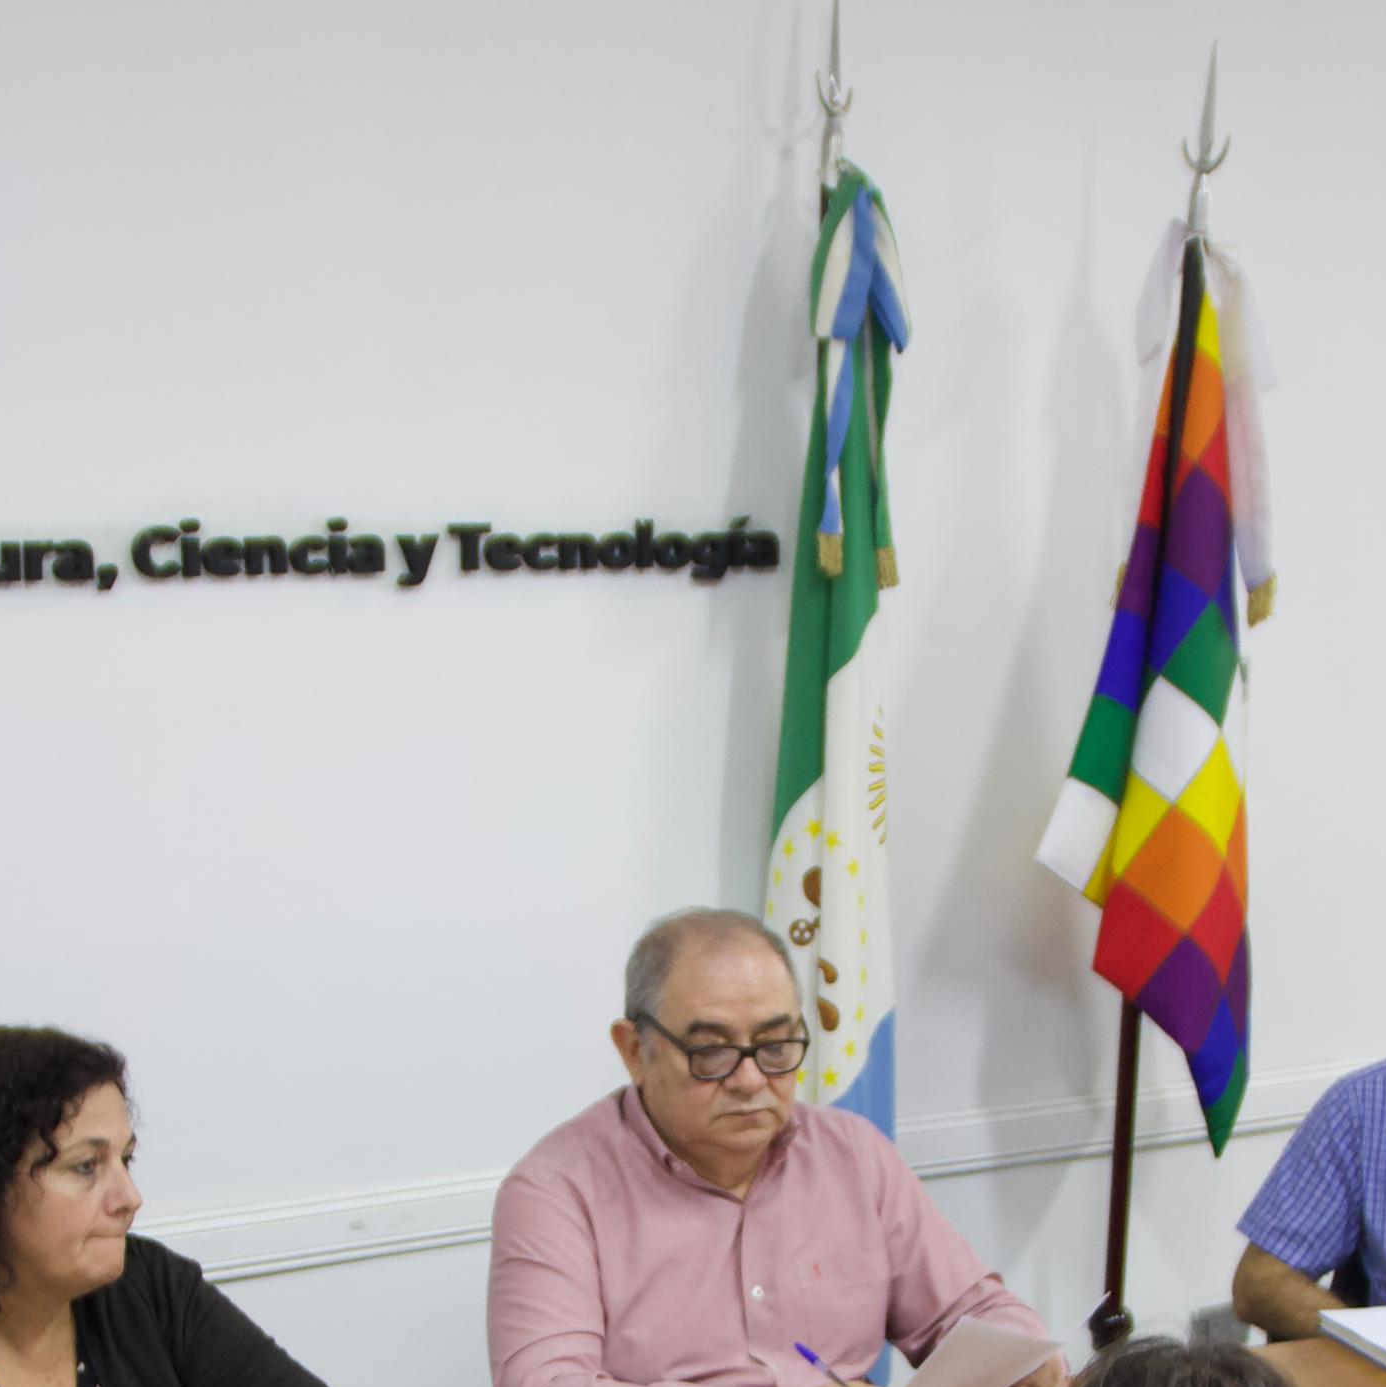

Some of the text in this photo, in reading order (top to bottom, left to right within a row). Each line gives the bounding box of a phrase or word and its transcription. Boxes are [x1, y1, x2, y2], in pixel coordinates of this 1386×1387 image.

[130, 516, 387, 579] Ciencia
[396, 534, 439, 587] y
[447, 515, 781, 583] Tecnología
